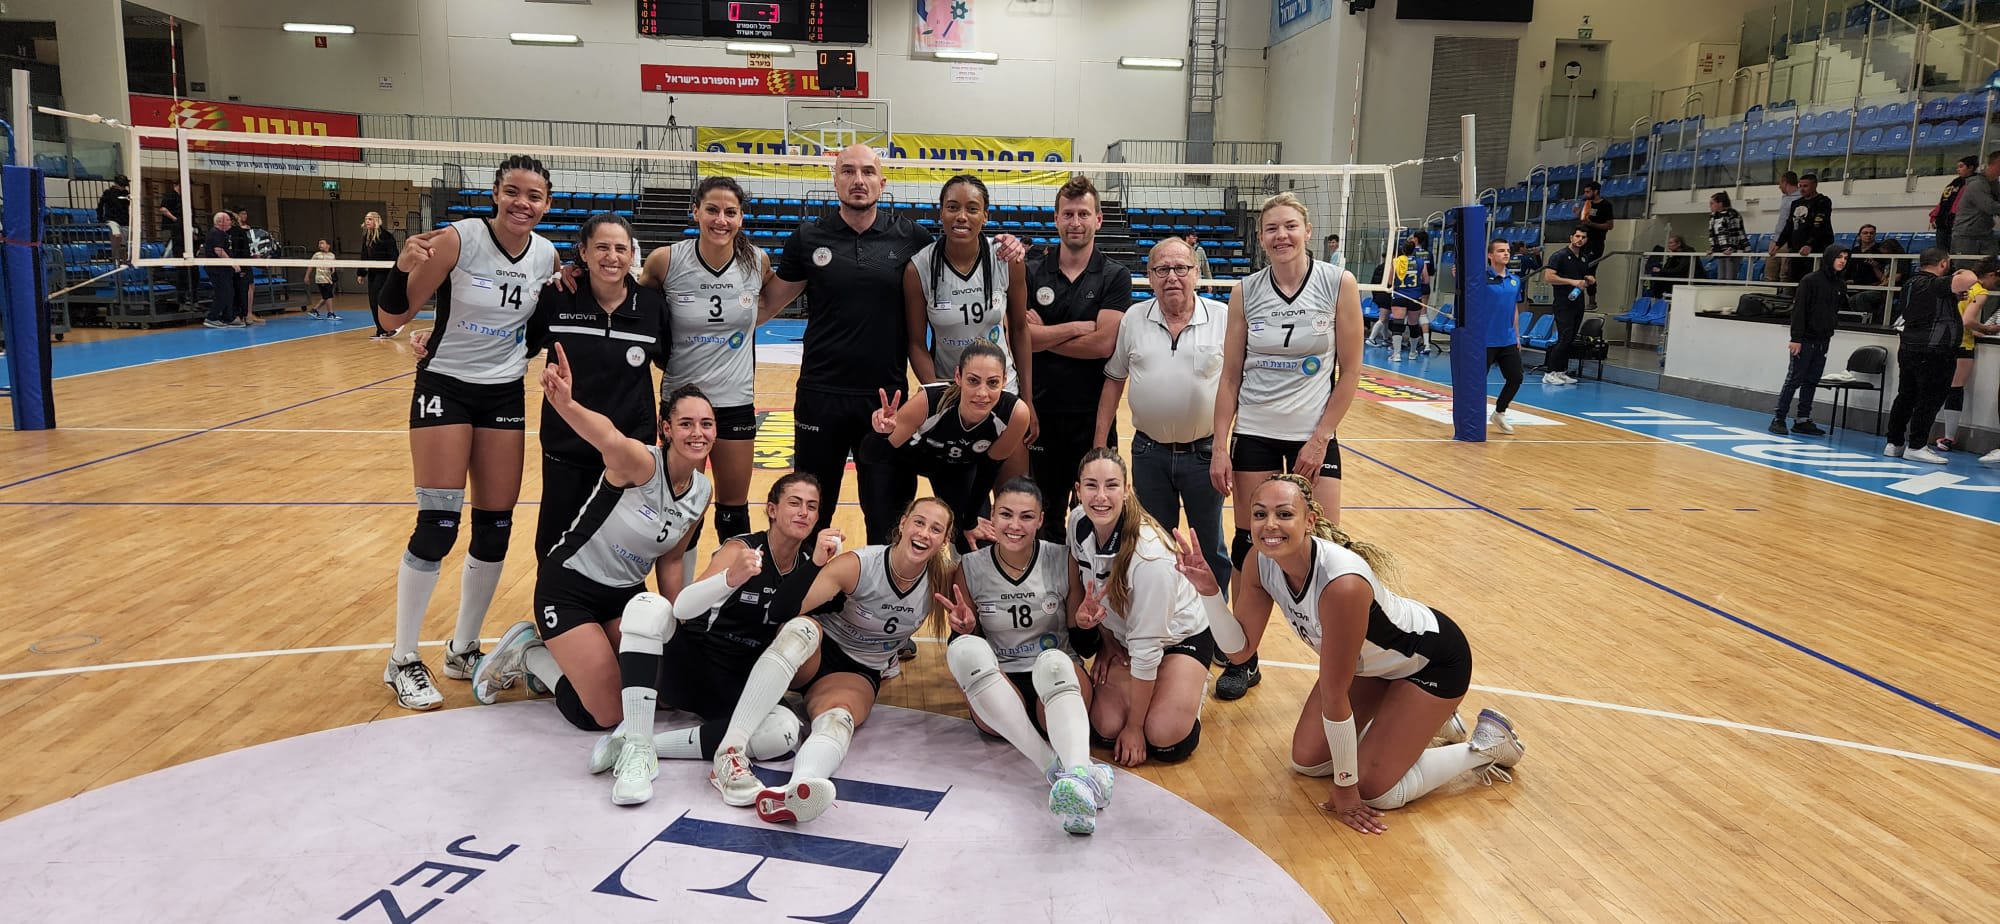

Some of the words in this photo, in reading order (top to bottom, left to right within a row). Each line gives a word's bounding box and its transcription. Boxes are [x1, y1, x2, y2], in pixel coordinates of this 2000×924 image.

[664, 72, 700, 85] בישראל
[702, 76, 736, 86] הספורט
[738, 75, 760, 88] למען
[495, 269, 527, 279] GIVOVA
[499, 283, 522, 310] 14
[951, 287, 983, 296] GIVOVA
[709, 294, 723, 318] 3
[559, 313, 597, 321] GIVOVA
[960, 302, 984, 326] 19
[1271, 309, 1306, 317] GIVOVA
[1281, 324, 1295, 348] 7
[418, 394, 444, 419] 14
[949, 446, 962, 458] 8
[656, 520, 672, 543] 5
[1000, 591, 1036, 600] GIVOVA
[881, 603, 914, 614] GIVOVA
[543, 605, 558, 629] 5
[1007, 604, 1033, 629] 18
[883, 616, 899, 634] 6
